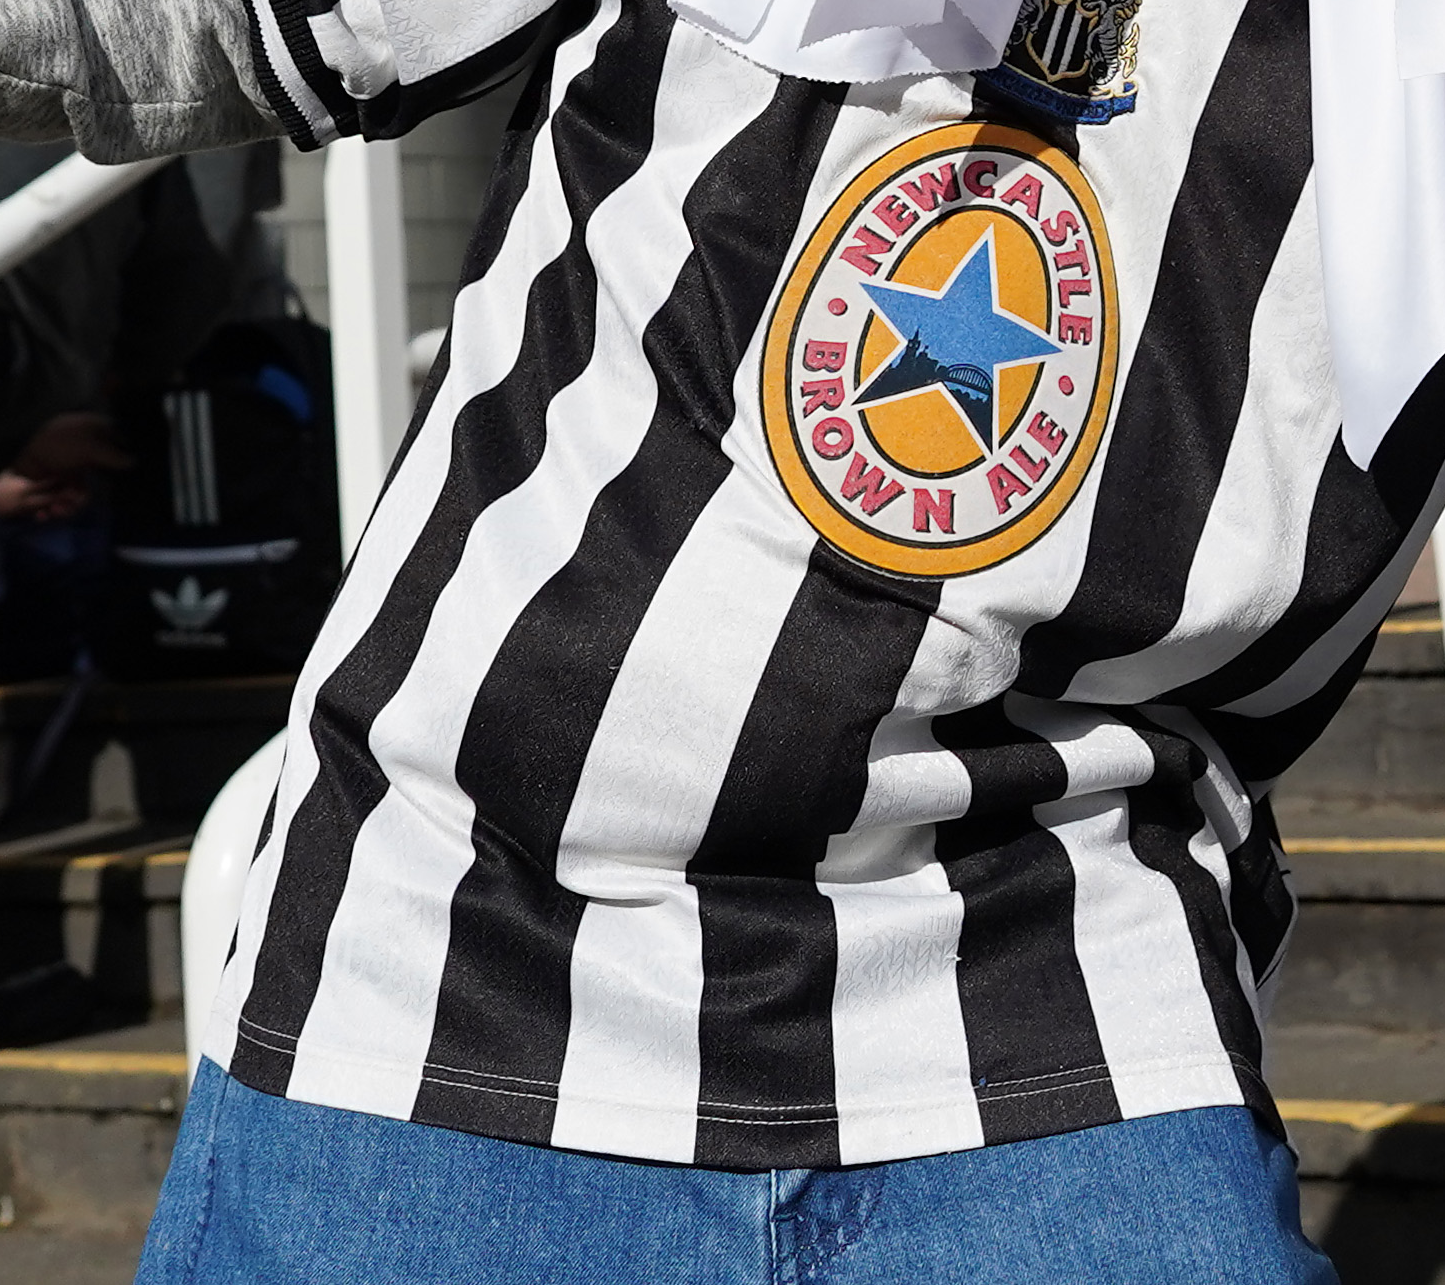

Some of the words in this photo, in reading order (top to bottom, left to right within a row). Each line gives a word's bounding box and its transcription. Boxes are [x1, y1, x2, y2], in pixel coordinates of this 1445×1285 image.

[838, 158, 1092, 347] NEWCASTLE
[801, 338, 956, 535] BROWN
[986, 409, 1066, 517] ALE
